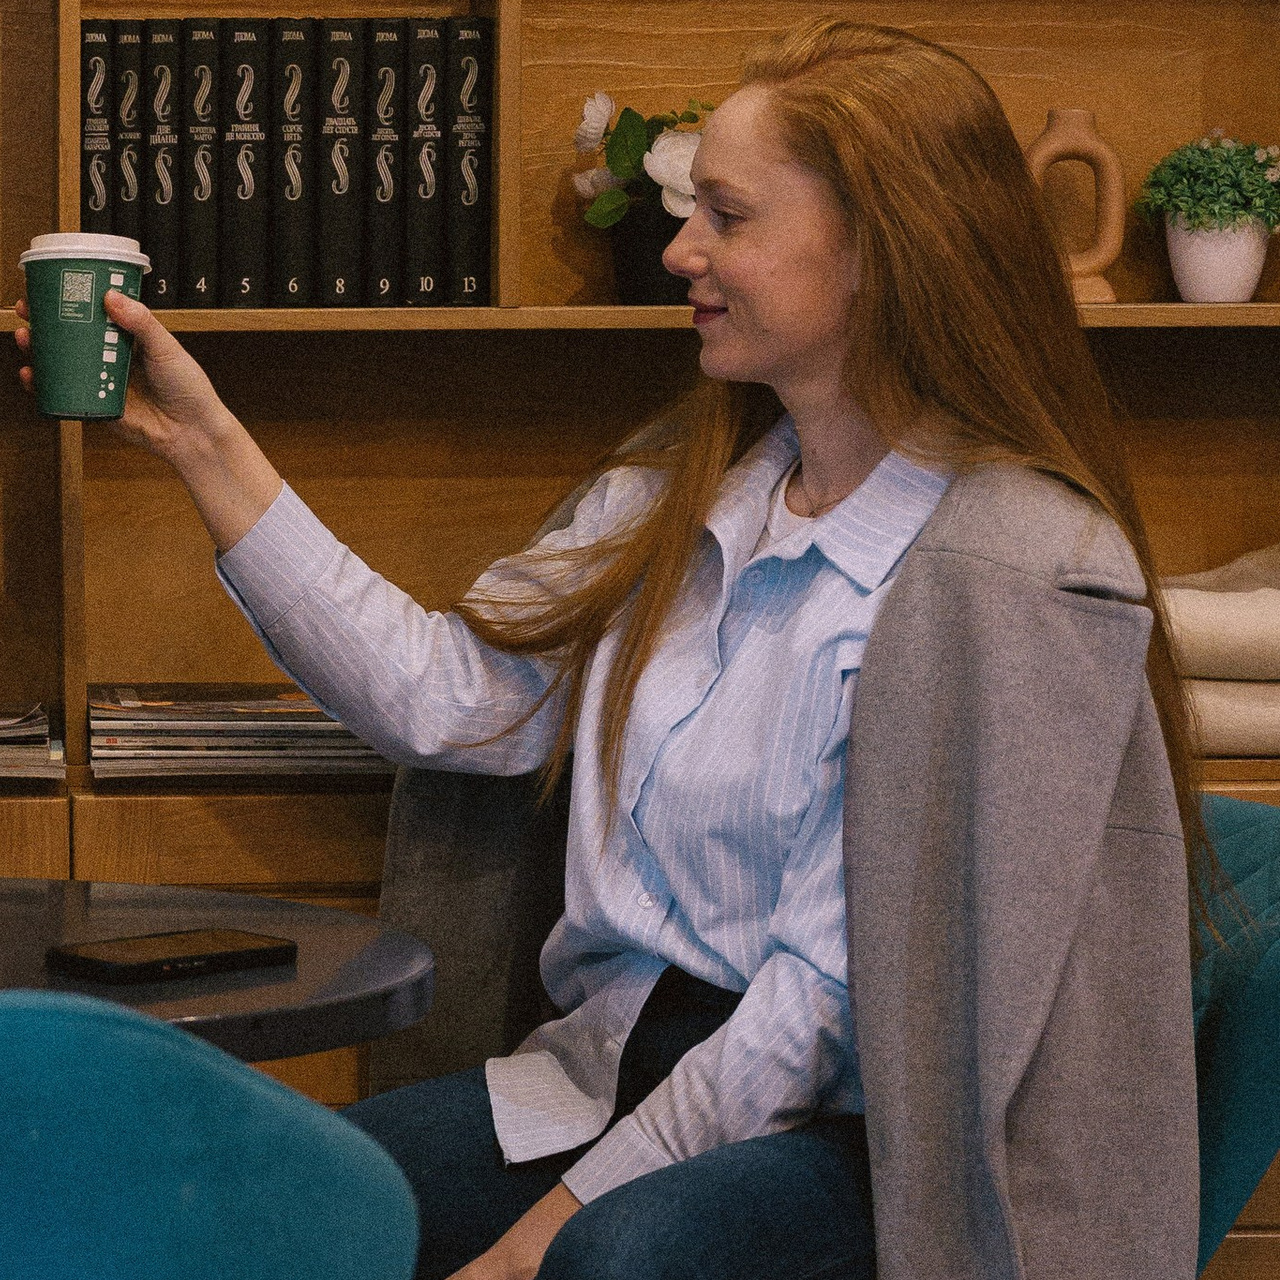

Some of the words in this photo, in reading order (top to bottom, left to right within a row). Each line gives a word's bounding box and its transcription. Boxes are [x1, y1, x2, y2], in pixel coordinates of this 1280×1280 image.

[158, 279, 167, 294] 3
[196, 277, 207, 292] 4
[241, 278, 250, 293] 5
[288, 277, 298, 293] 6
[335, 278, 345, 294] 8
[379, 278, 390, 295] 9
[420, 276, 434, 292] 10
[463, 276, 477, 293] 13
